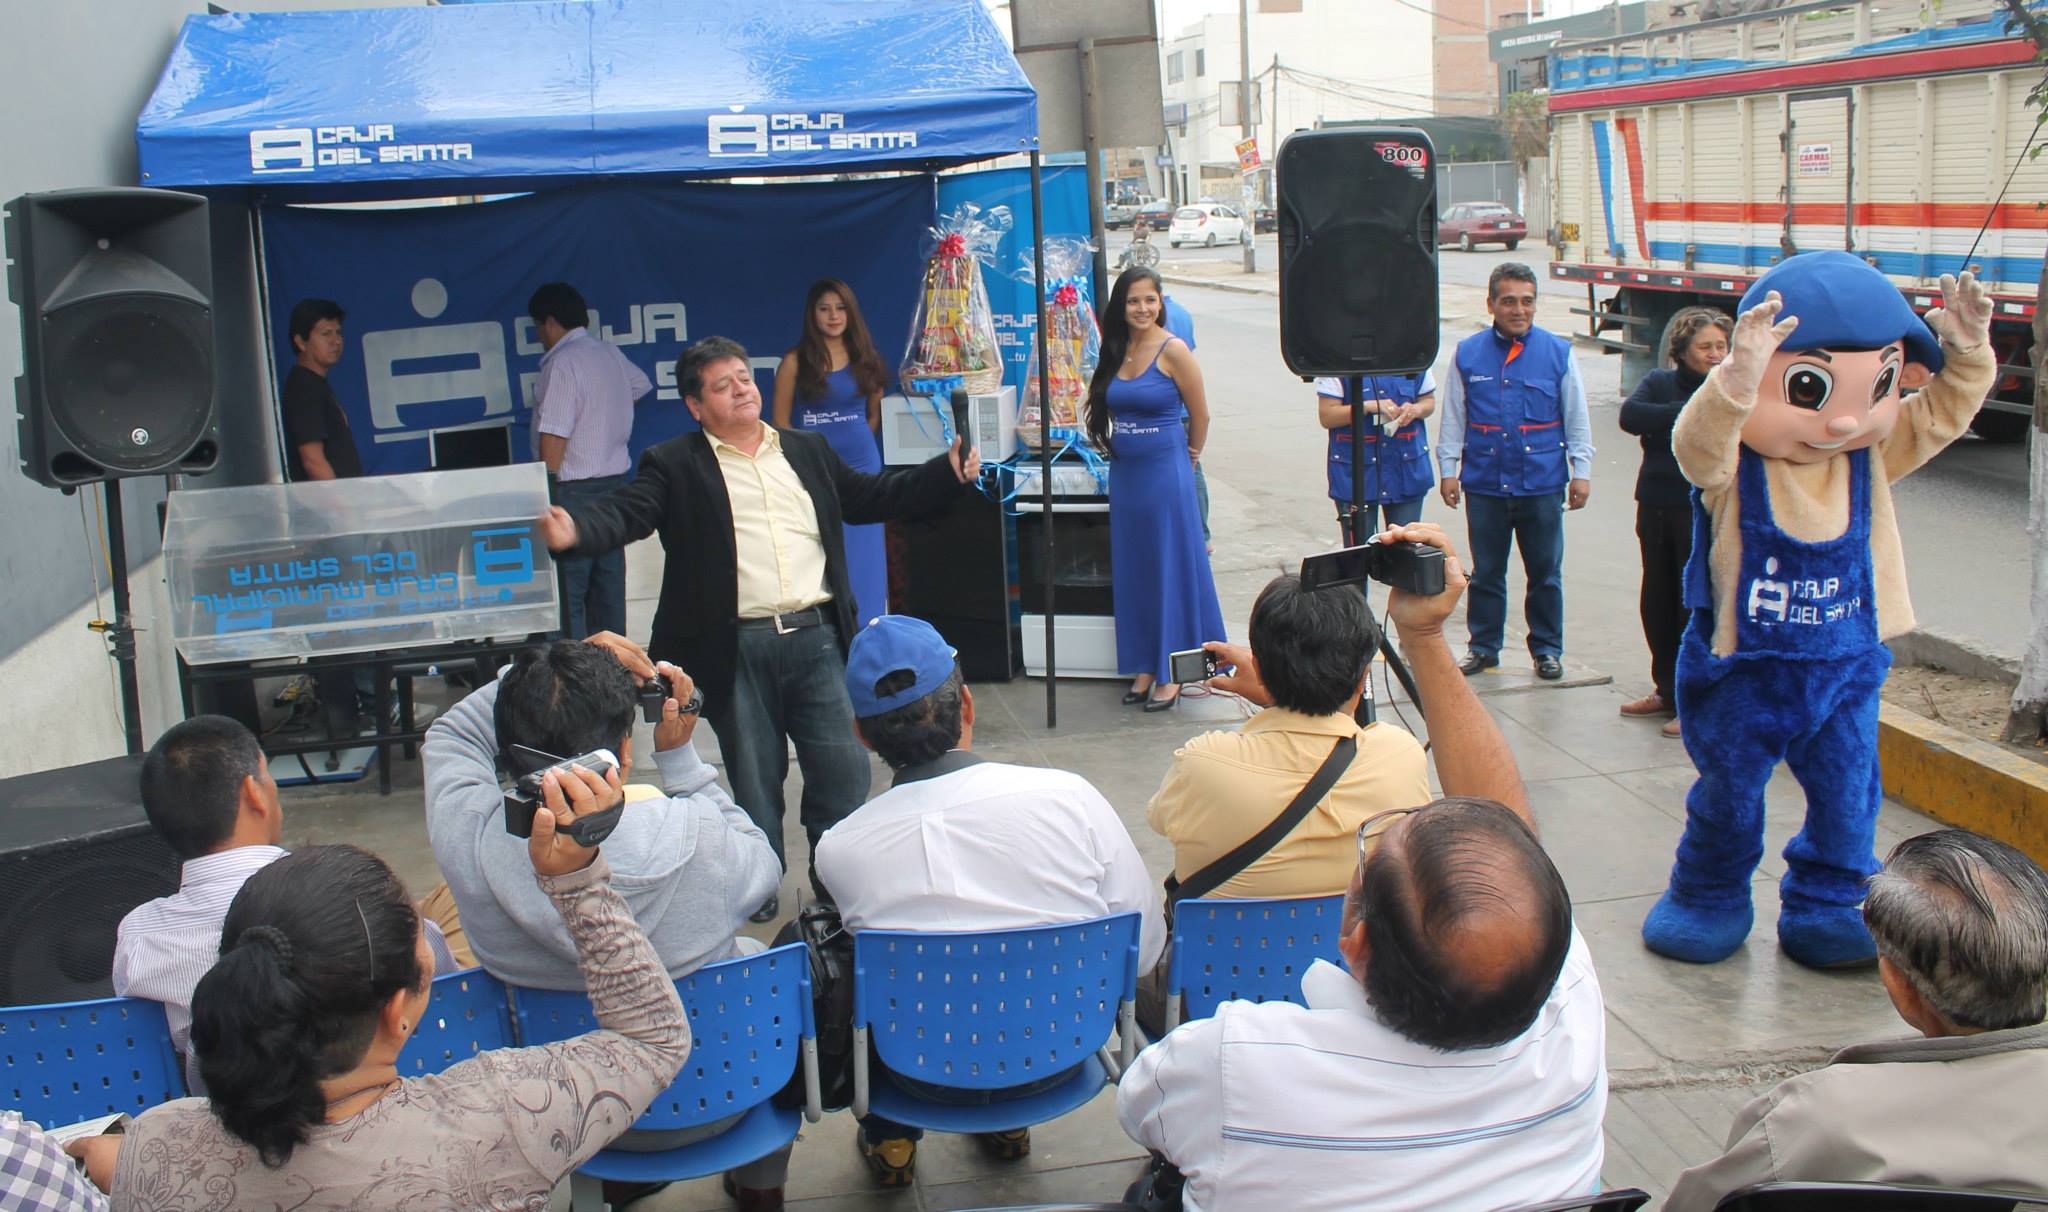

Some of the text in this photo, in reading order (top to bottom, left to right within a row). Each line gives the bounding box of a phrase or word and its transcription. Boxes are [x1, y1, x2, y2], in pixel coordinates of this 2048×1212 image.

[771, 113, 844, 130] CAJA
[316, 124, 395, 144] CAJA
[771, 131, 917, 152] DEL SANTA
[318, 143, 473, 165] DEL SANTA
[1383, 147, 1423, 162] 800
[229, 551, 416, 587] DEL SANTA
[192, 572, 459, 615] CAJA MUNICIPAL
[1792, 577, 1840, 599] CAJA
[1788, 596, 1861, 625] DEL SANA
